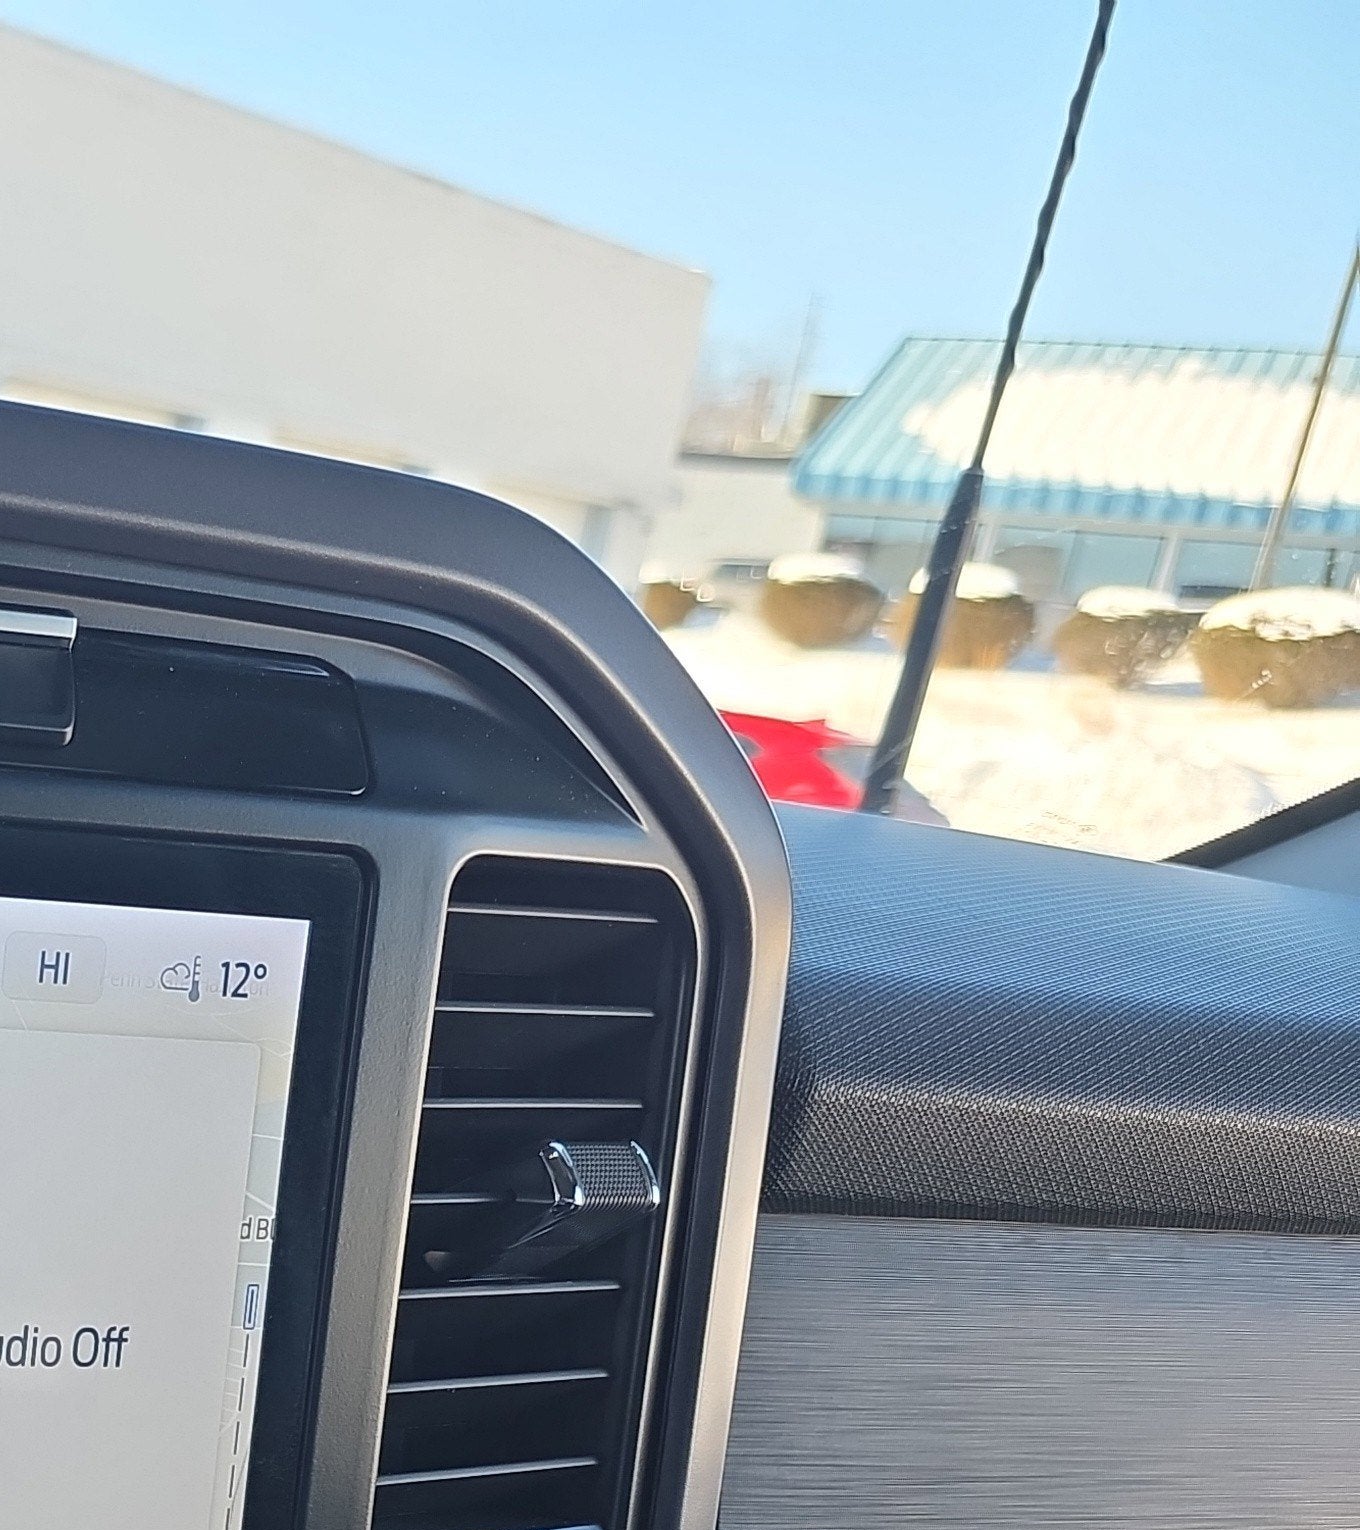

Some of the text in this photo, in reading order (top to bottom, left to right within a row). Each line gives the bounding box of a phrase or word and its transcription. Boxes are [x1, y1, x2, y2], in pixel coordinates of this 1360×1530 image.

[38, 950, 70, 985] HI
[221, 961, 267, 999] 12°
[72, 1326, 130, 1368] Off
